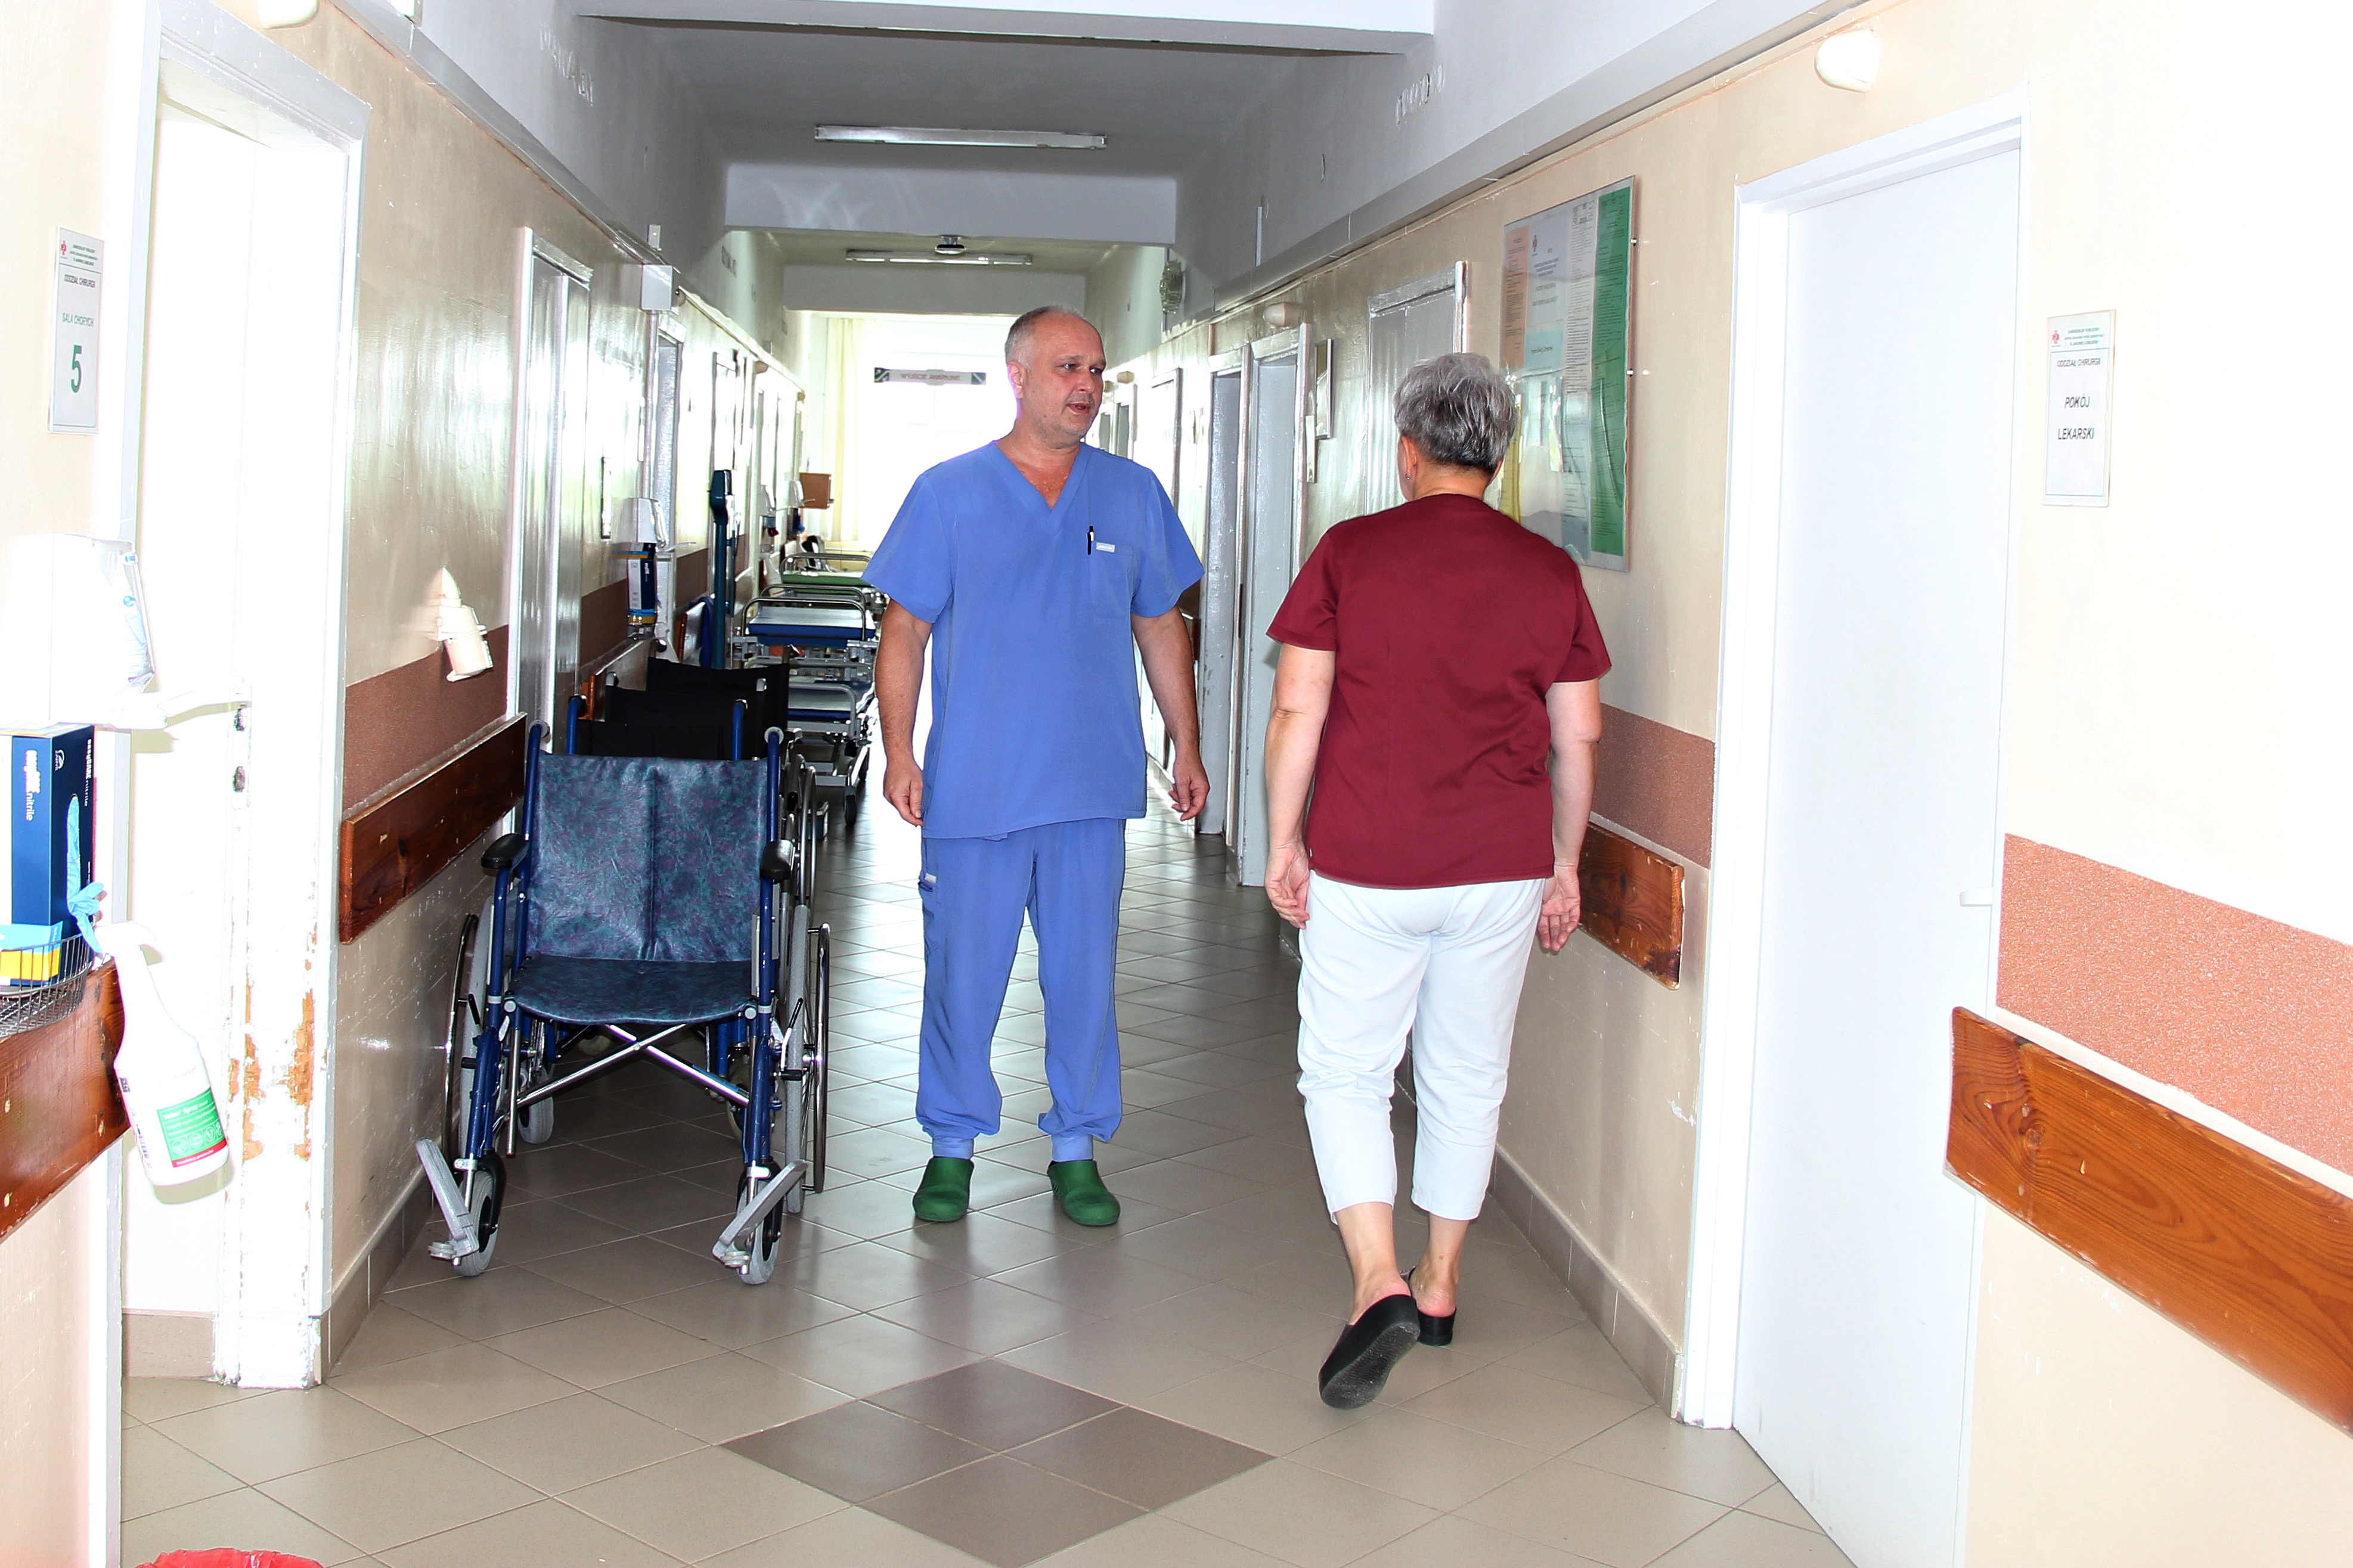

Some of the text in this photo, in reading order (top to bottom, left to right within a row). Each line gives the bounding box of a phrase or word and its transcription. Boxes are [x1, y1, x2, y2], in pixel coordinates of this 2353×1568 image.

[62, 312, 94, 327] SALA CHORYCH
[71, 344, 82, 393] 5
[2064, 393, 2091, 408] POKÓJ
[2057, 427, 2095, 440] LEKARSKI
[26, 793, 36, 821] nitrile
